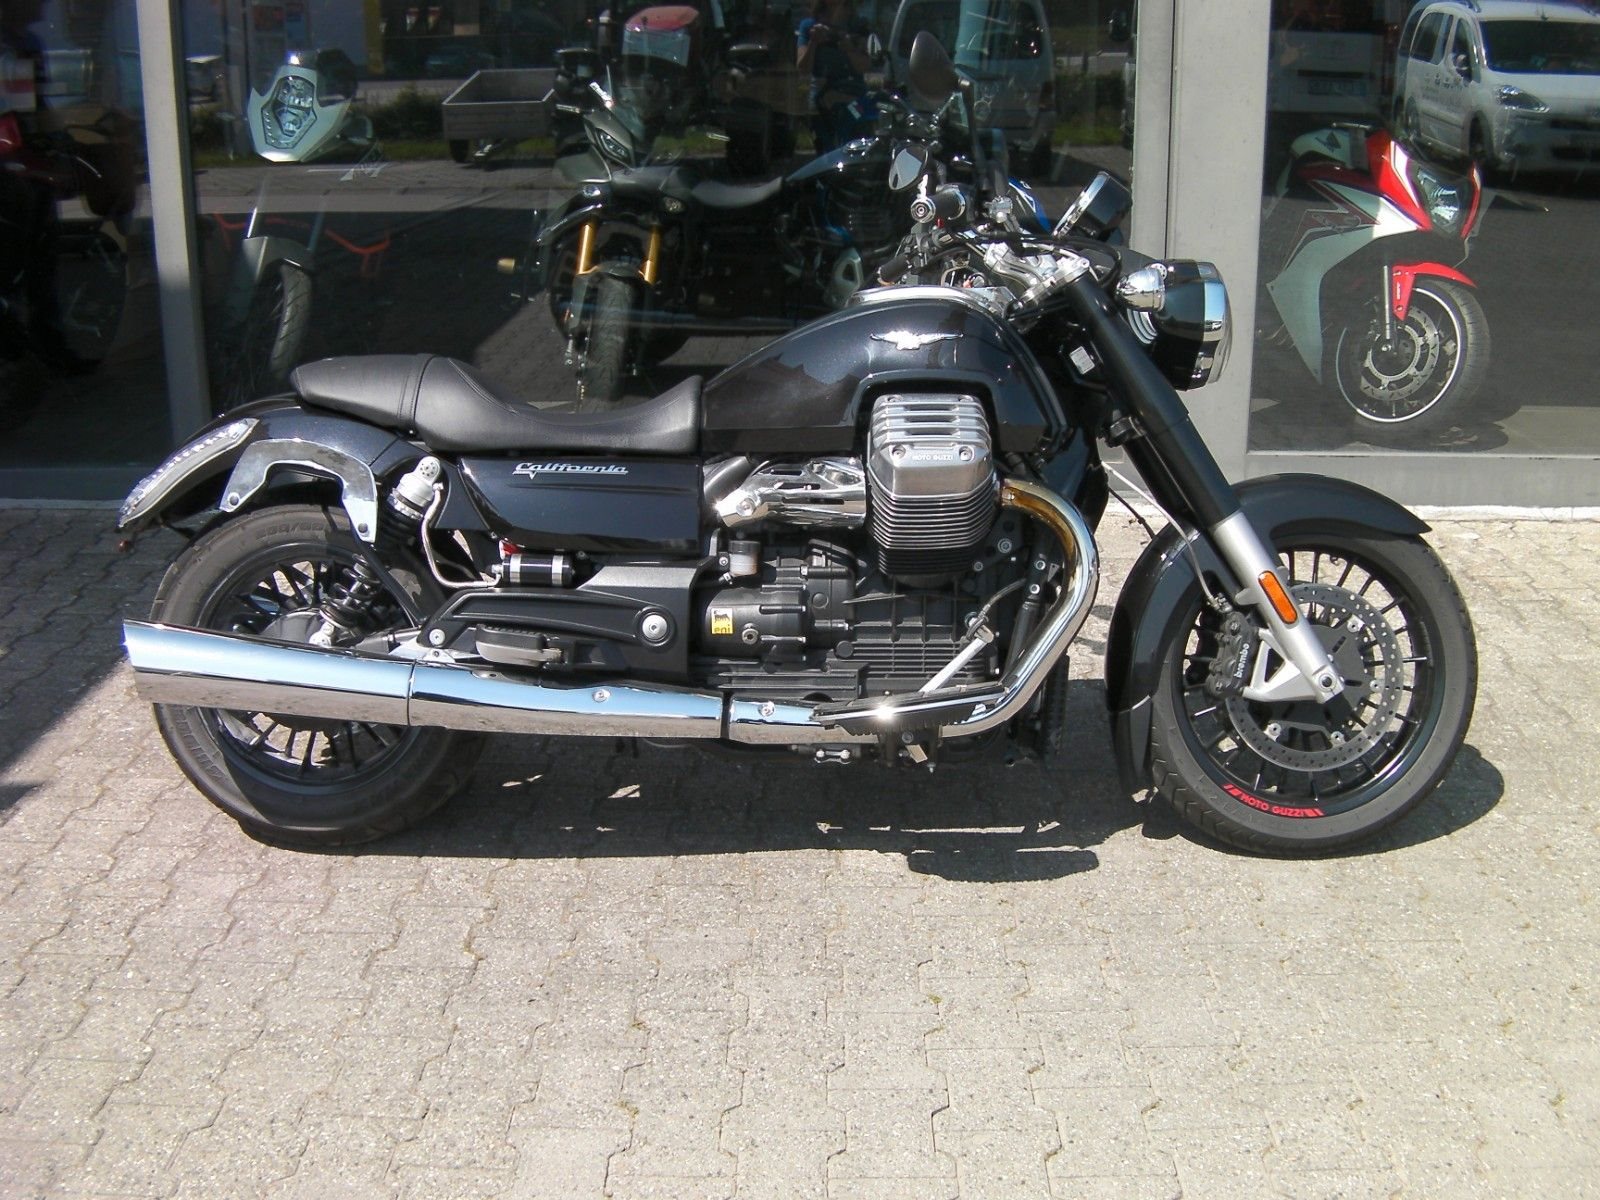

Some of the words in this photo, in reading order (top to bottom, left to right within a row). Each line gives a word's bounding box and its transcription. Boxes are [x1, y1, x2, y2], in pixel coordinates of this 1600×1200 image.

[512, 462, 629, 479] California
[714, 624, 731, 634] eni
[1233, 643, 1250, 678] brembo
[1240, 793, 1269, 811] MOTO
[1271, 806, 1304, 818] GUZZI
